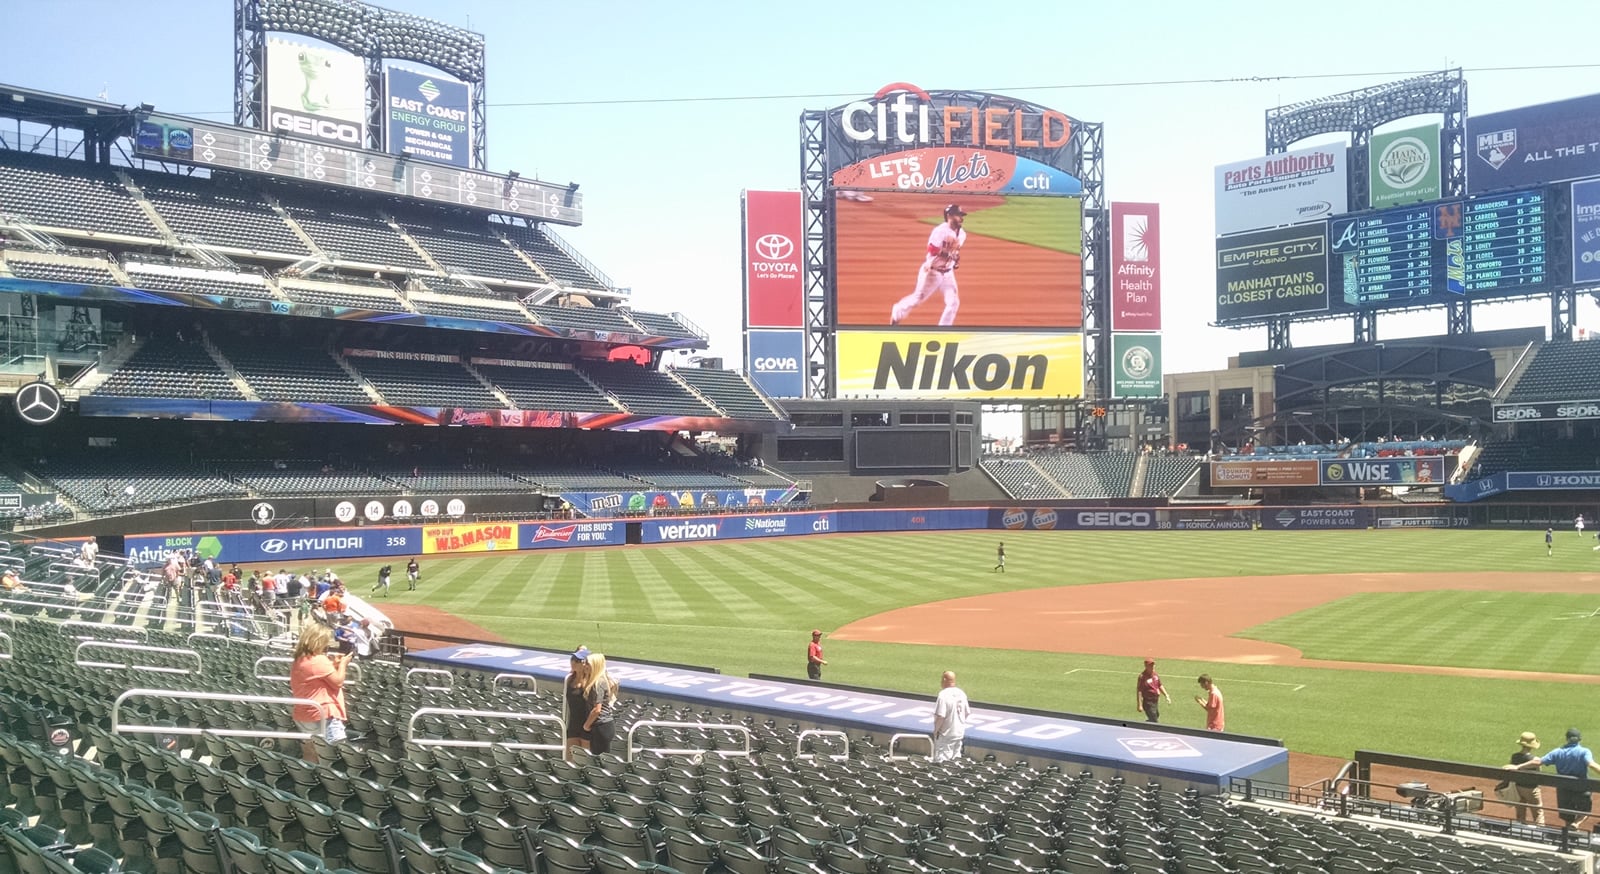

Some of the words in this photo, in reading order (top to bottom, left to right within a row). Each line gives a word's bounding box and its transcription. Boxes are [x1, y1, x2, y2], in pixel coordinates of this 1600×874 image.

[391, 96, 423, 112] EAST
[426, 104, 466, 121] COAST
[391, 111, 430, 126] ENERGY
[433, 119, 466, 133] GROUP
[841, 93, 928, 143] citi
[943, 105, 1071, 148] FIELD
[272, 112, 358, 143] GEICO
[404, 127, 430, 138] POWER
[437, 133, 452, 142] GAS
[1480, 131, 1514, 147] MLB
[404, 136, 452, 151] MECHANICAL
[1392, 149, 1417, 159] HAIN
[1524, 151, 1552, 163] ALL
[1555, 145, 1585, 158] THE
[869, 156, 921, 179] LET'S
[897, 173, 924, 189] GO
[925, 152, 988, 190] Mets
[1224, 165, 1261, 184] Parts
[1265, 152, 1334, 177] Authority
[1023, 175, 1050, 190] citi
[1228, 182, 1247, 190] Auto
[1249, 178, 1272, 186] Parts
[1273, 172, 1300, 182] Super
[1301, 167, 1332, 176] Stores
[1258, 185, 1287, 194] Answer
[1474, 200, 1508, 210] GRANDERSON
[1223, 248, 1279, 262] EMPIRE
[1252, 256, 1287, 266] CASINO
[1476, 261, 1502, 269] CONFORTO
[752, 262, 798, 272] TOYOTA
[1117, 264, 1155, 277] Affinity
[1120, 279, 1153, 290] Health
[1227, 271, 1314, 292] MANHATTAN'S
[1126, 291, 1147, 303] Plan
[1218, 288, 1273, 305] CLOSEST
[1276, 283, 1325, 298] CASINO
[376, 350, 395, 359] THIS
[754, 357, 797, 370] GOYA
[873, 340, 1049, 391] Nikon
[502, 414, 520, 424] VS
[339, 507, 351, 517] 37
[370, 506, 379, 515] 14
[398, 505, 407, 514] 41
[424, 505, 435, 513] 42
[754, 518, 786, 528] National
[1003, 515, 1026, 525] Gulf
[1033, 515, 1056, 525] Gulf
[1077, 512, 1151, 526] GEICO
[1301, 518, 1330, 526] POWER
[1453, 517, 1468, 526] 370
[577, 524, 592, 532] THIS
[593, 523, 613, 531] BUD'S
[659, 521, 717, 540] verizon
[813, 519, 829, 531] citi
[1157, 521, 1172, 529] 380
[426, 529, 440, 537] WHO
[536, 529, 573, 538] Budweiser
[577, 533, 590, 541] FOR
[592, 532, 607, 540] YOU.
[165, 537, 192, 546] BLOCK
[292, 537, 363, 551] HYUNDAI
[386, 537, 406, 546] 358
[707, 682, 786, 699] TO
[774, 692, 897, 714] CITI
